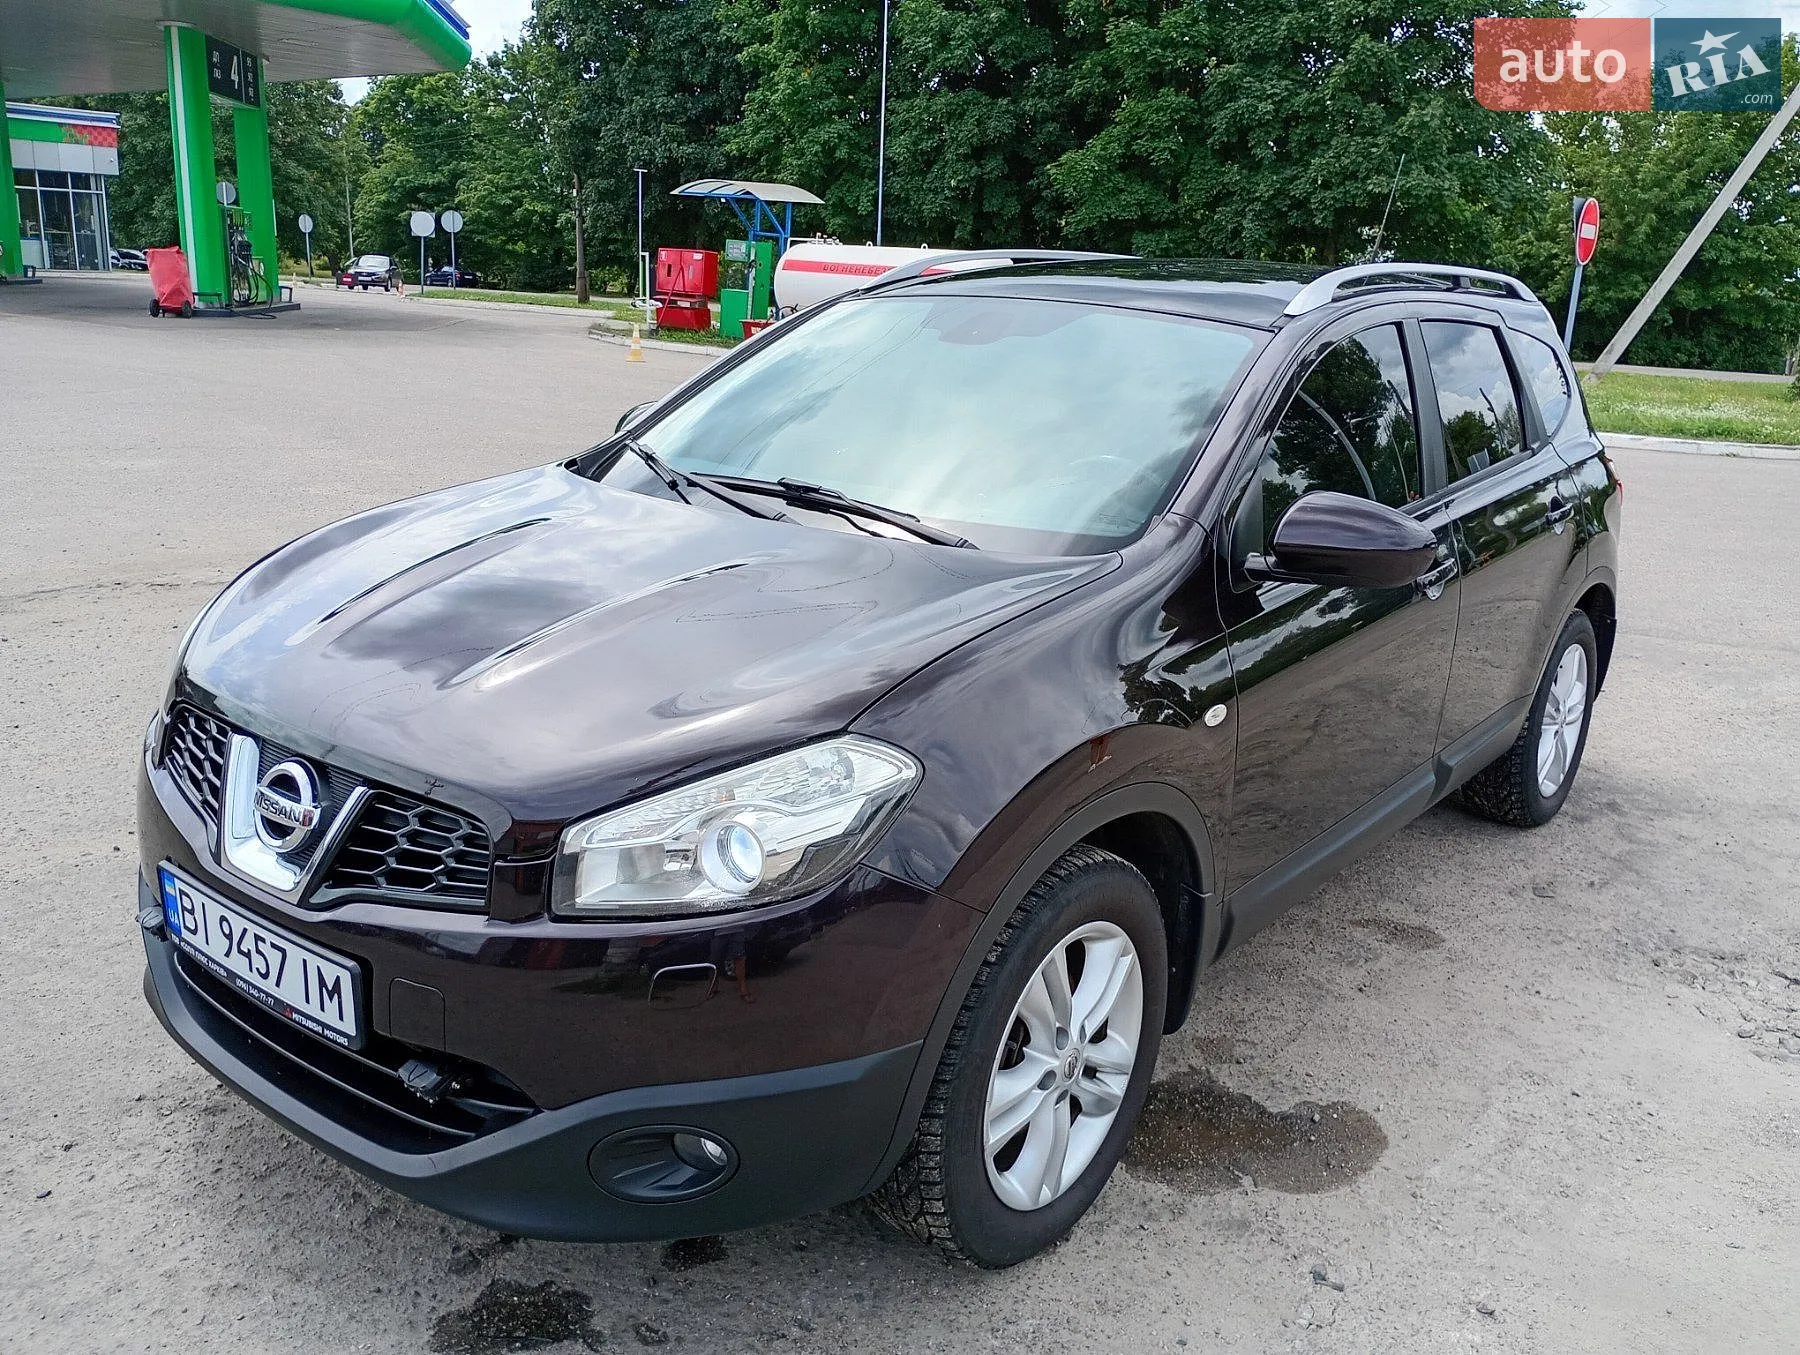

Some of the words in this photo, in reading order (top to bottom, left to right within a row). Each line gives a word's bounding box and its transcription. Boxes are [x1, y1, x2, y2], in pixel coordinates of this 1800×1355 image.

[230, 55, 239, 90] 4
[822, 264, 887, 275] ВОГНЕНЕБЕЗ
[254, 791, 302, 826] NISSAN
[169, 908, 180, 926] UA
[178, 887, 209, 946] BI
[219, 915, 288, 988] 9457
[302, 958, 344, 1022] IM
[292, 1012, 323, 1034] MITSUBISHI
[323, 1028, 349, 1046] MOTORS
